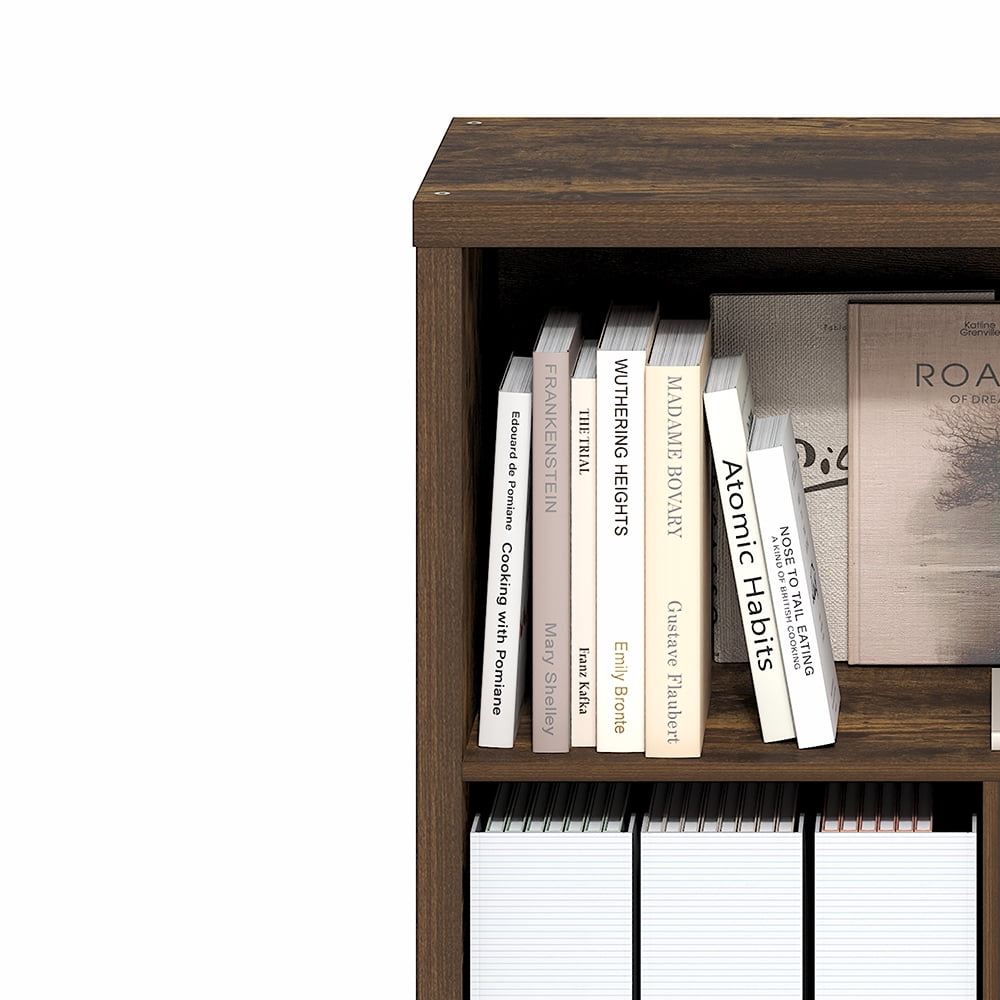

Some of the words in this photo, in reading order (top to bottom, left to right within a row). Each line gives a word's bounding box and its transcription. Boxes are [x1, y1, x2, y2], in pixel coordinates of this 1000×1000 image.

[959, 328, 1000, 337] Grenville
[579, 408, 590, 434] THE
[614, 358, 628, 459] WUTHERING
[667, 375, 682, 460] MADAME
[950, 395, 967, 404] OF
[508, 411, 520, 459] Edouard
[544, 364, 558, 514] FRANKENSTEIN
[579, 436, 590, 475] TRIAL
[508, 462, 517, 477] de
[505, 480, 516, 531] Pomiane
[614, 464, 628, 537] HEIGHTS
[667, 465, 683, 538] BOVARY
[771, 535, 778, 543] A
[772, 544, 783, 569] KIND
[780, 525, 796, 566] NOSE
[496, 542, 512, 606] Cooking
[722, 459, 757, 565] Atomic
[743, 576, 774, 672] Habits
[777, 570, 786, 584] OF
[787, 569, 799, 588] TO
[780, 585, 793, 623] BRITISH
[791, 591, 804, 622] TAIL
[496, 611, 508, 644] with
[542, 623, 557, 666] Mary
[667, 600, 683, 667] Gustave
[787, 625, 801, 670] COOKING
[579, 647, 590, 678] Franz
[611, 641, 628, 682] Emily
[797, 624, 815, 677] EATING
[492, 650, 506, 716] Pomiane
[542, 672, 557, 736] Shelley
[579, 681, 590, 715] Kafka
[614, 686, 628, 734] Bronte
[667, 674, 683, 744] Flaubert
